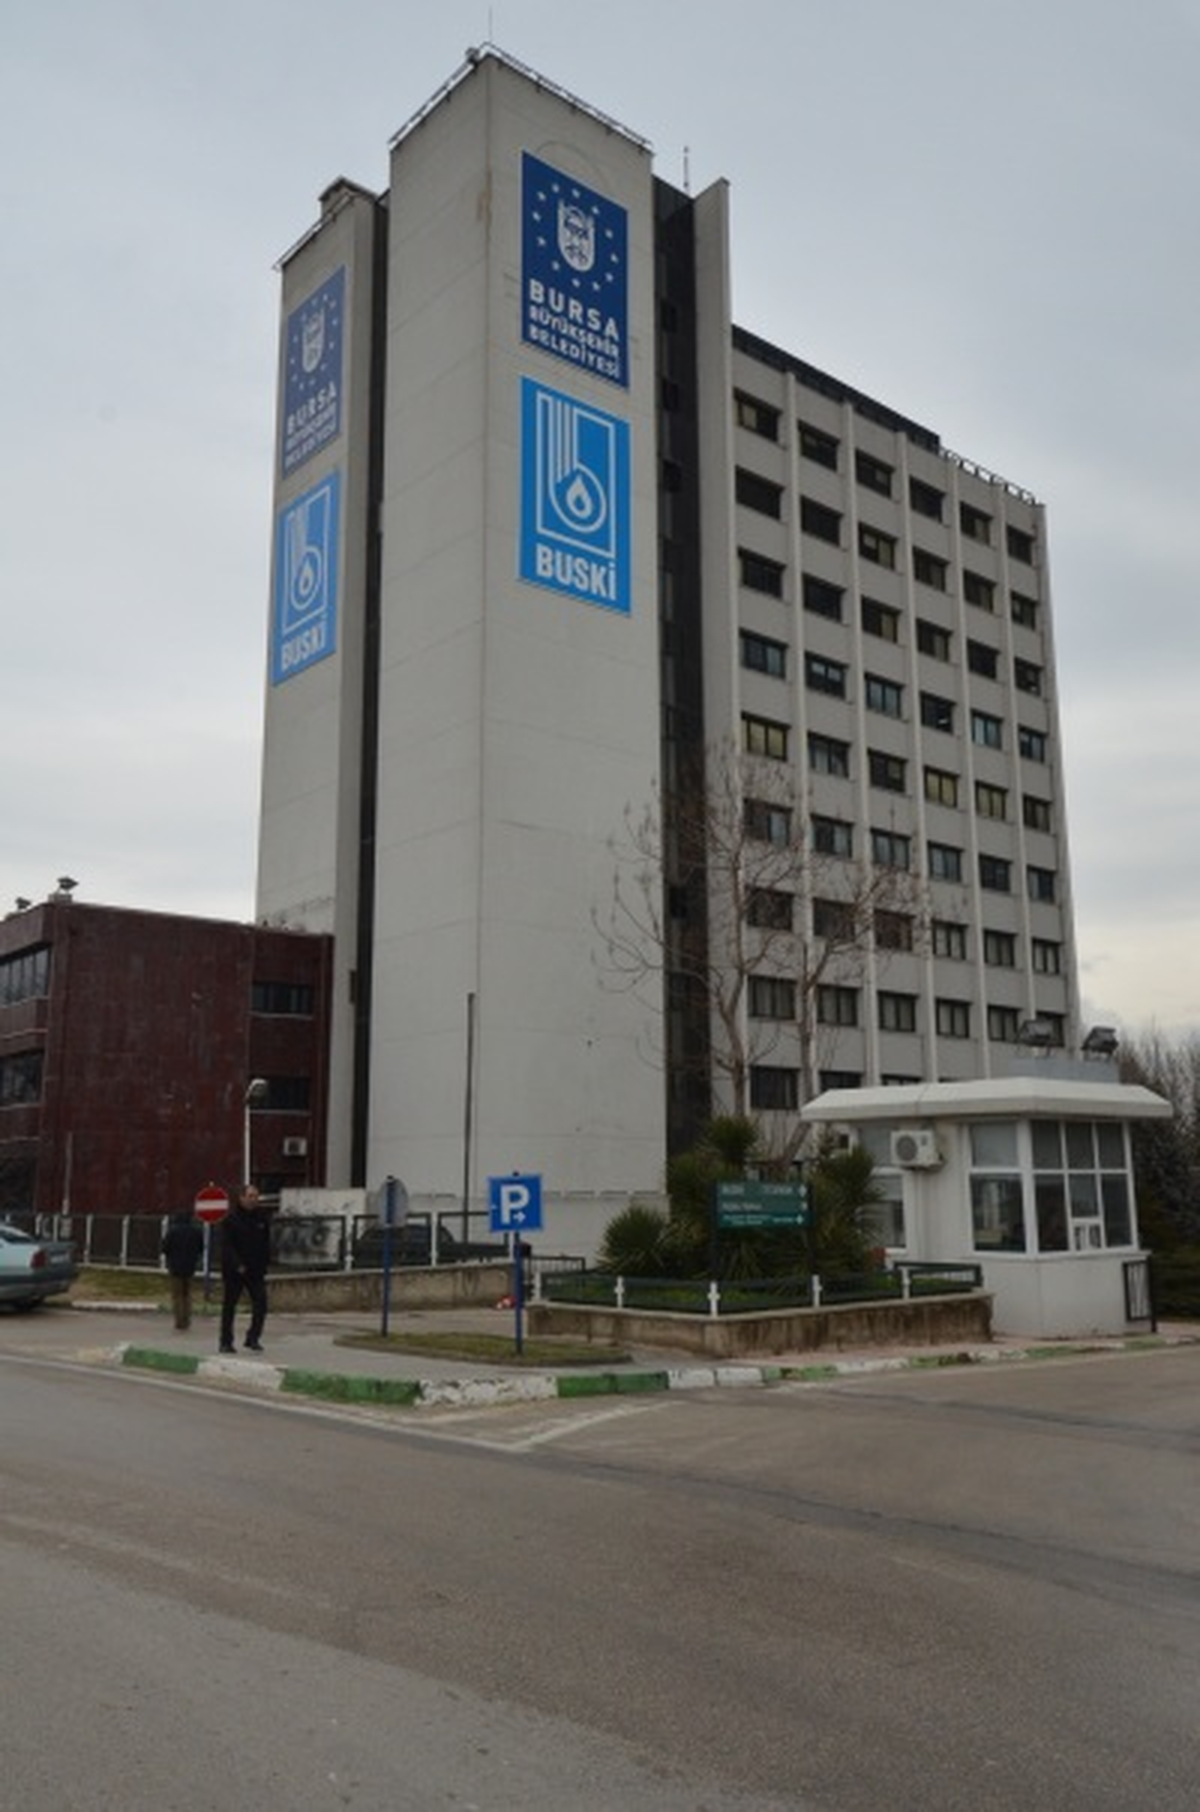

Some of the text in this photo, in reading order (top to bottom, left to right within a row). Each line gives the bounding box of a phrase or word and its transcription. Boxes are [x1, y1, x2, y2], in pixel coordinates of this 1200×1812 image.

[530, 279, 619, 342] BURSA
[287, 381, 337, 435] BURSA
[536, 543, 616, 600] BUSKİ
[501, 1186, 530, 1224] P
